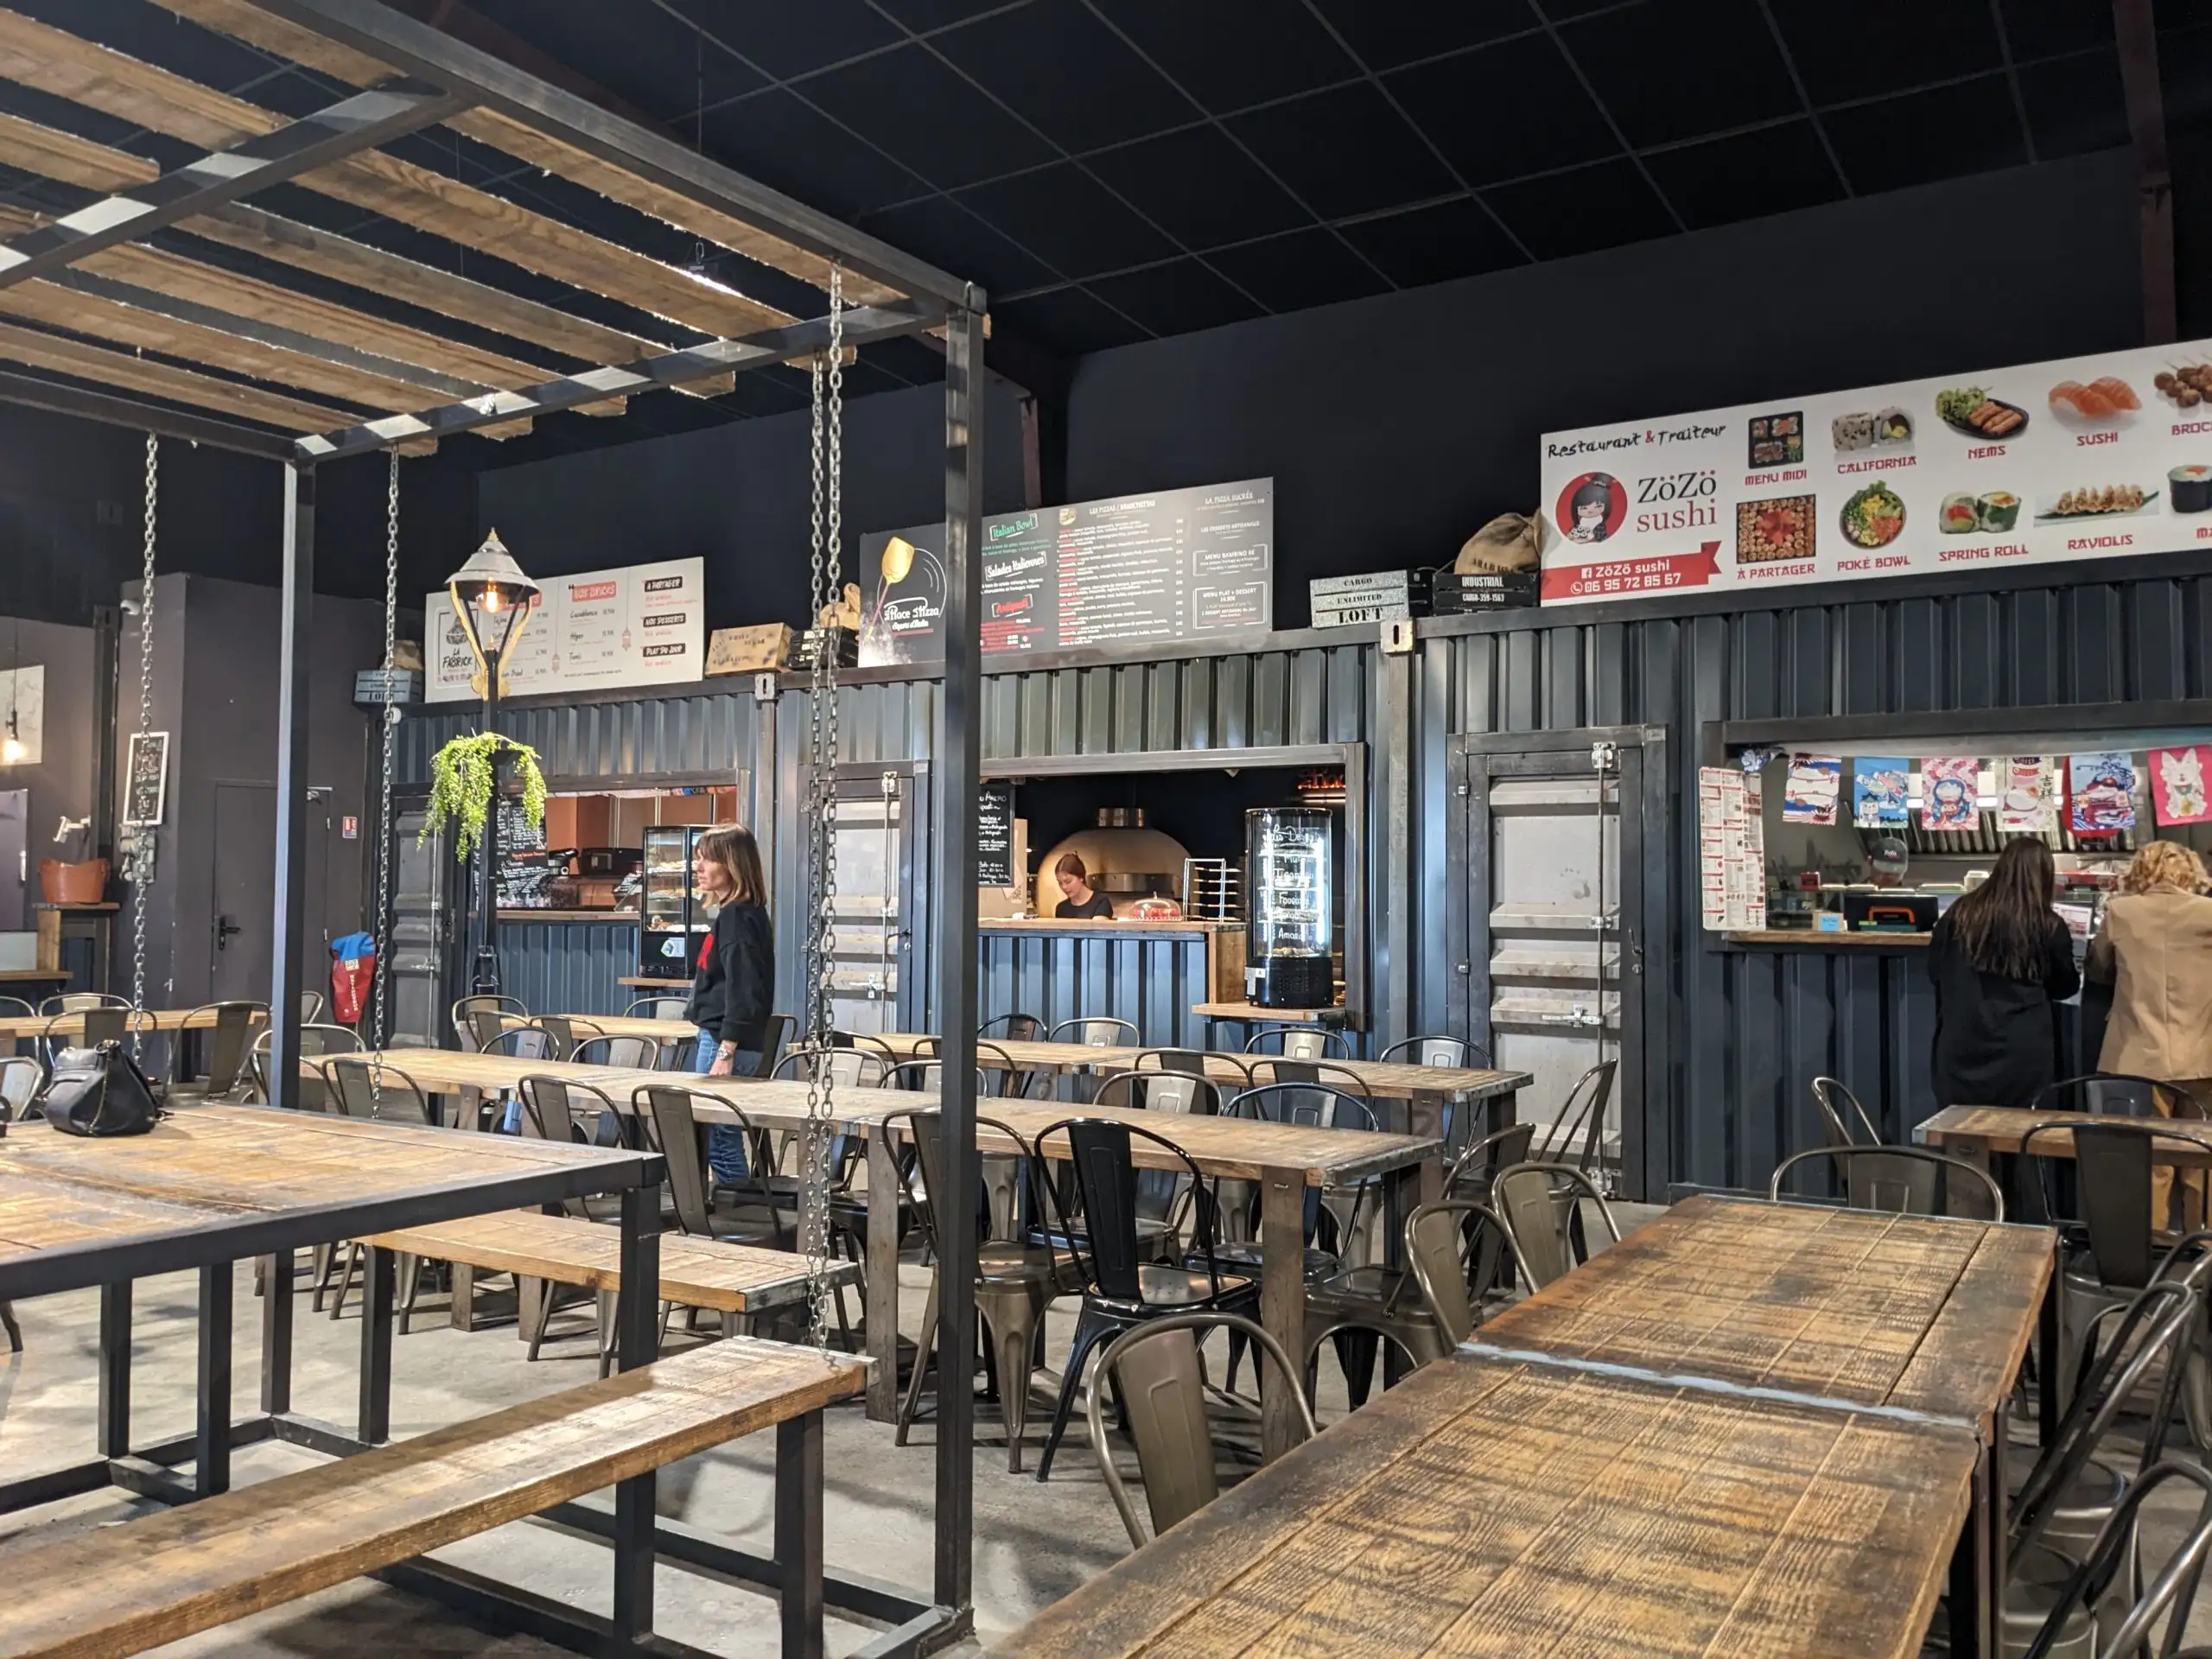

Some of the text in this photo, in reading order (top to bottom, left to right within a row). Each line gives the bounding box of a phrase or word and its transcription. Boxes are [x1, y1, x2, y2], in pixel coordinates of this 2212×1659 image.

[1548, 426, 1726, 458] Restaurant & Traiteur
[2076, 432, 2119, 447] SUSHI
[1967, 445, 2006, 460] NEMS
[1837, 455, 1916, 474] CALIFORNIA
[1745, 468, 1807, 486] MENU MIDI
[1637, 470, 1717, 503] ZöZö
[1637, 499, 1718, 532] sushi
[993, 518, 1033, 538] Italian Bowl
[2068, 534, 2133, 550] RAVIOLIS
[1939, 544, 2029, 563] SPRING ROLL
[1635, 559, 1669, 572] sushi
[1875, 555, 1910, 569] BOWL
[987, 563, 1012, 578] Salades
[1750, 563, 1815, 578] PARTAGER
[1344, 576, 1373, 587] CARGO
[1462, 576, 1504, 588] INDUSTRIAL
[1585, 573, 1681, 592] 06 95 72 85 67
[1337, 594, 1382, 606] UNLIMITED
[1338, 607, 1383, 624] LOFT
[442, 656, 473, 669] FABRICK
